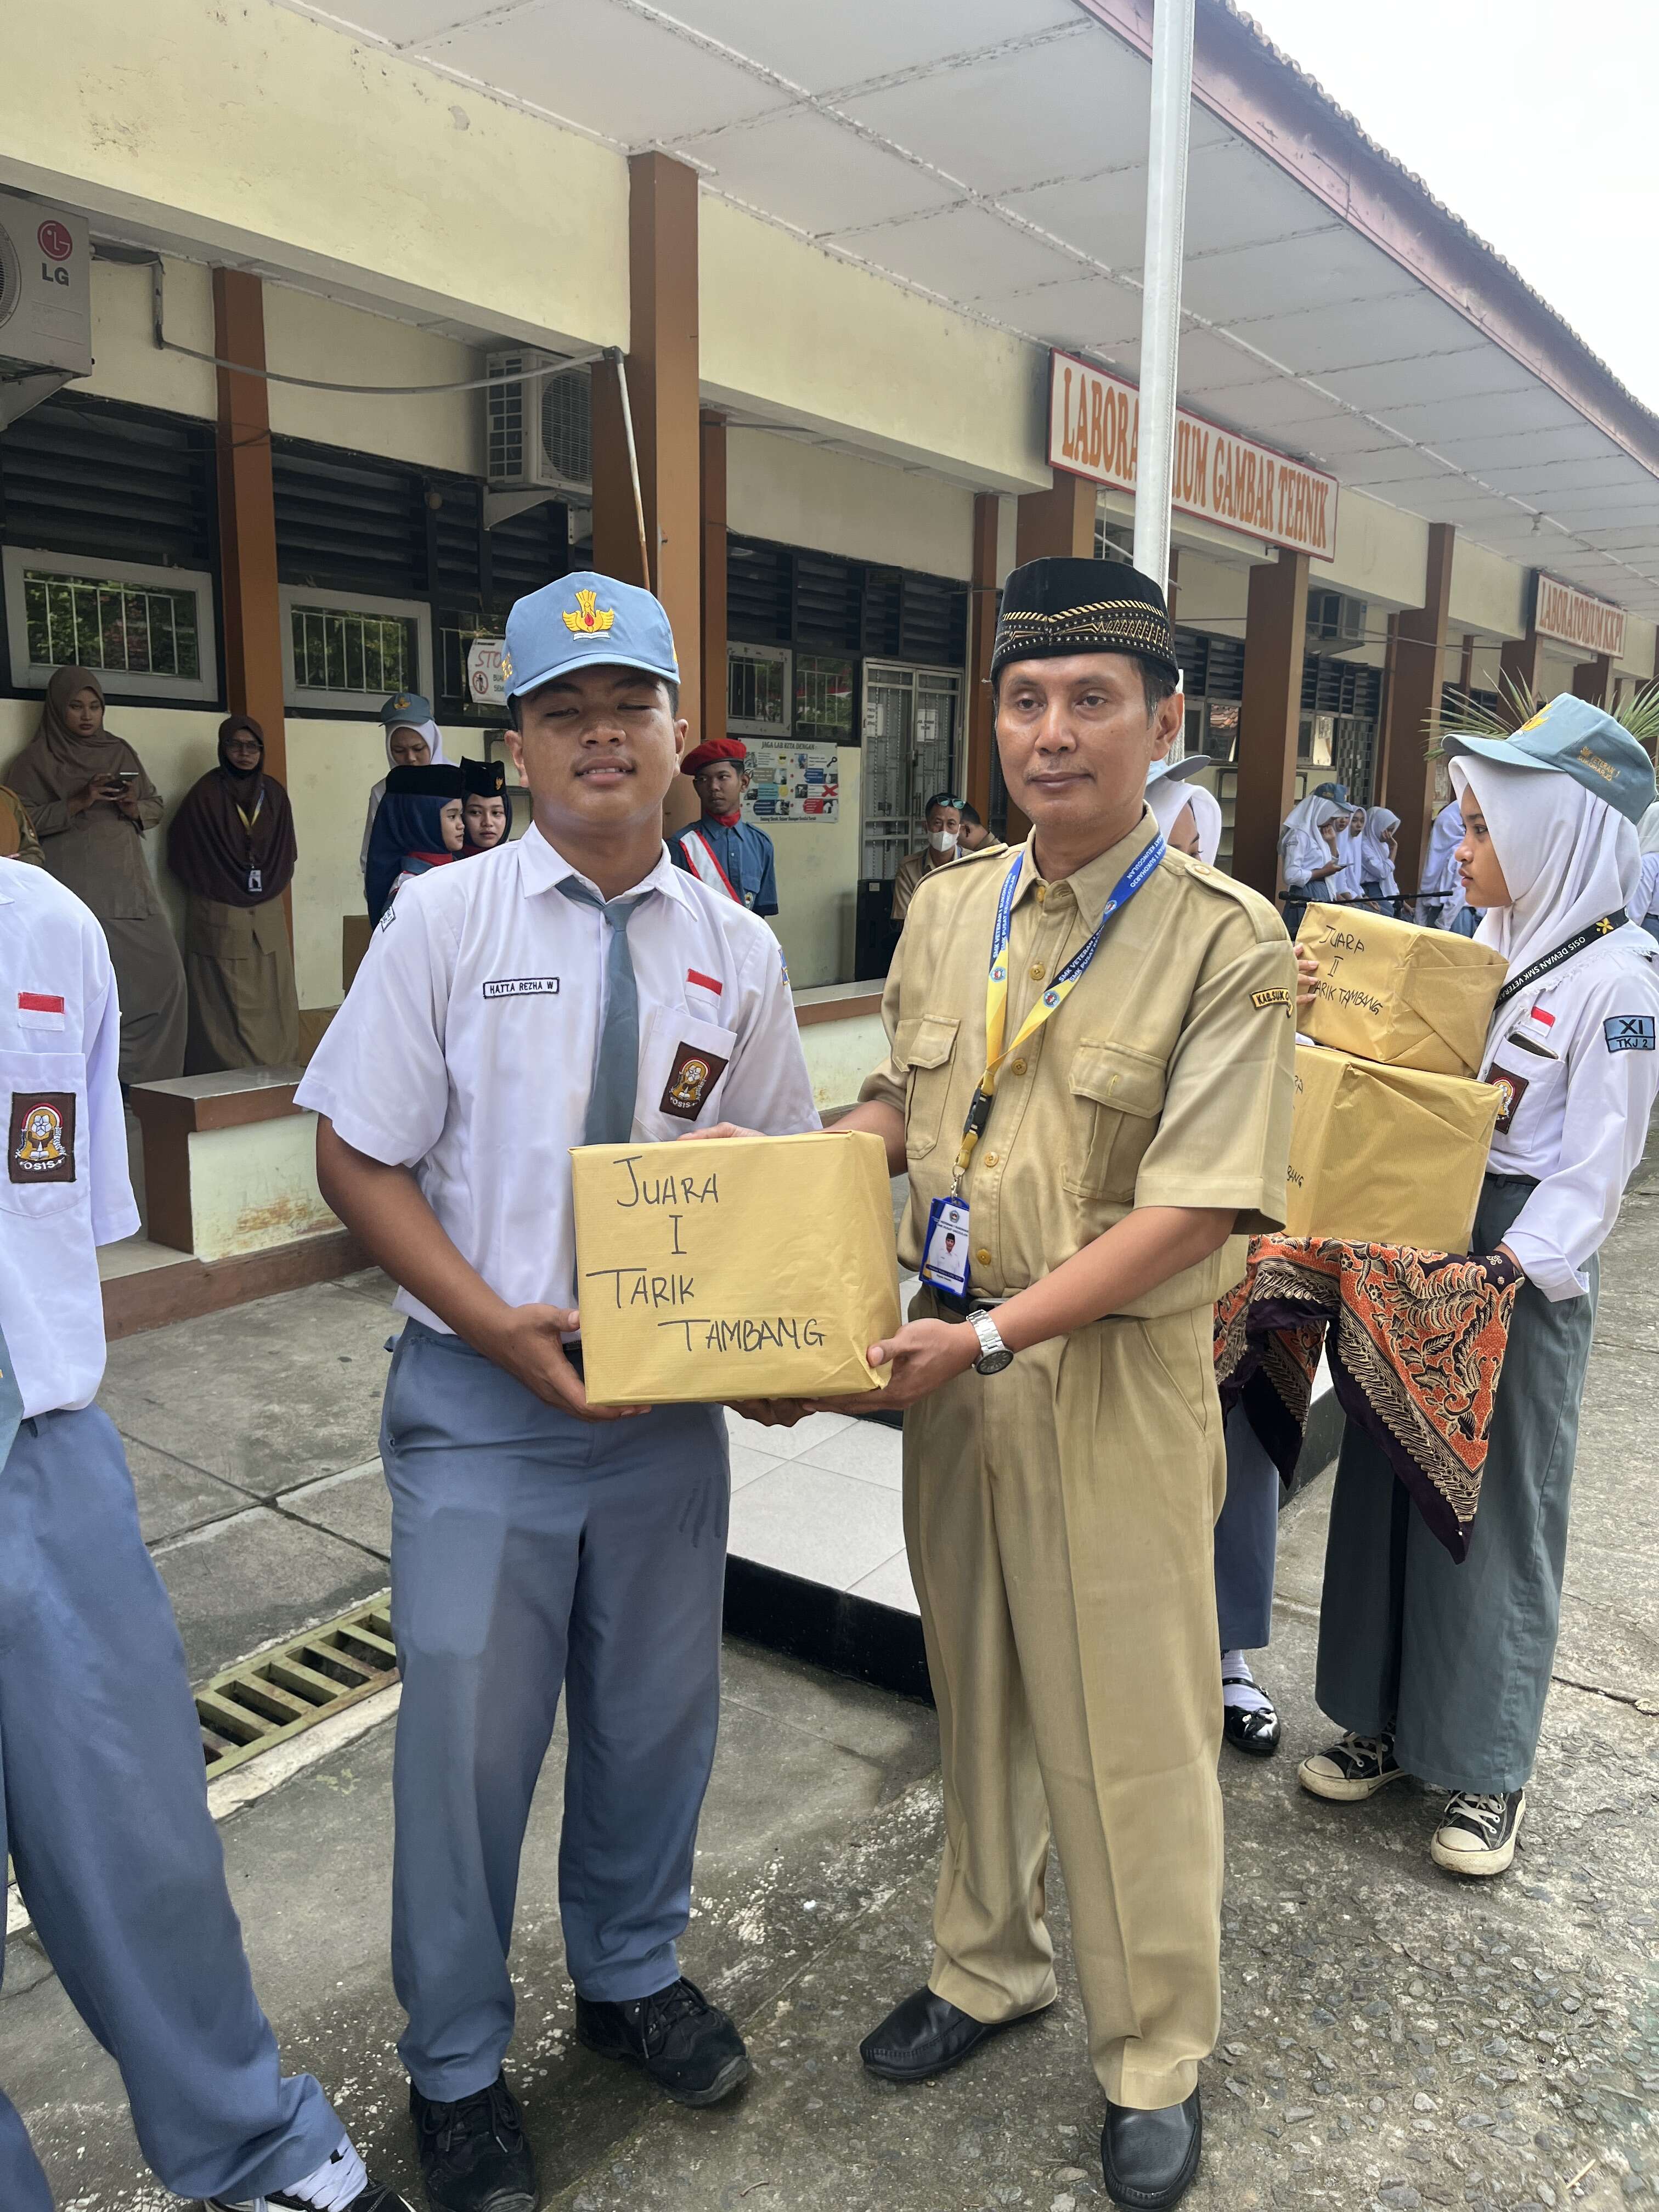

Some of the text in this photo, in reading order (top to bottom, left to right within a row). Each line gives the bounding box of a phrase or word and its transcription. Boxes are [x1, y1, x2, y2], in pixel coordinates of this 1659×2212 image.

[42, 263, 69, 286] LG
[1062, 368, 1329, 549] LABORAIUM GAMBAR TEHNIK
[1539, 581, 1604, 649] LABORATORIUM
[475, 650, 501, 668] STO
[1130, 856, 1156, 888] SUKOHARJO
[1319, 925, 1364, 953] JUARA
[1568, 936, 1585, 951] OSIS
[1058, 967, 1073, 983] SMK
[1070, 940, 1093, 968] VETERAN
[1069, 948, 1094, 983] SMK PUSAT
[1539, 948, 1568, 969] DEWAN
[1523, 966, 1540, 980] SMK
[490, 983, 515, 994] HATTA
[519, 981, 543, 991] REZHA
[1308, 980, 1383, 1015] ARIK TAMBANG
[1619, 1019, 1644, 1035] XI
[1616, 1037, 1648, 1048] TKJ 2
[672, 1098, 691, 1108] OSIS
[24, 1160, 57, 1171] OSIS
[1286, 1165, 1304, 1188] BANG
[613, 1155, 719, 1207] JUARA
[669, 1214, 687, 1255] I
[586, 1267, 695, 1308] TARIK
[658, 1317, 827, 1352] TAMBANG
